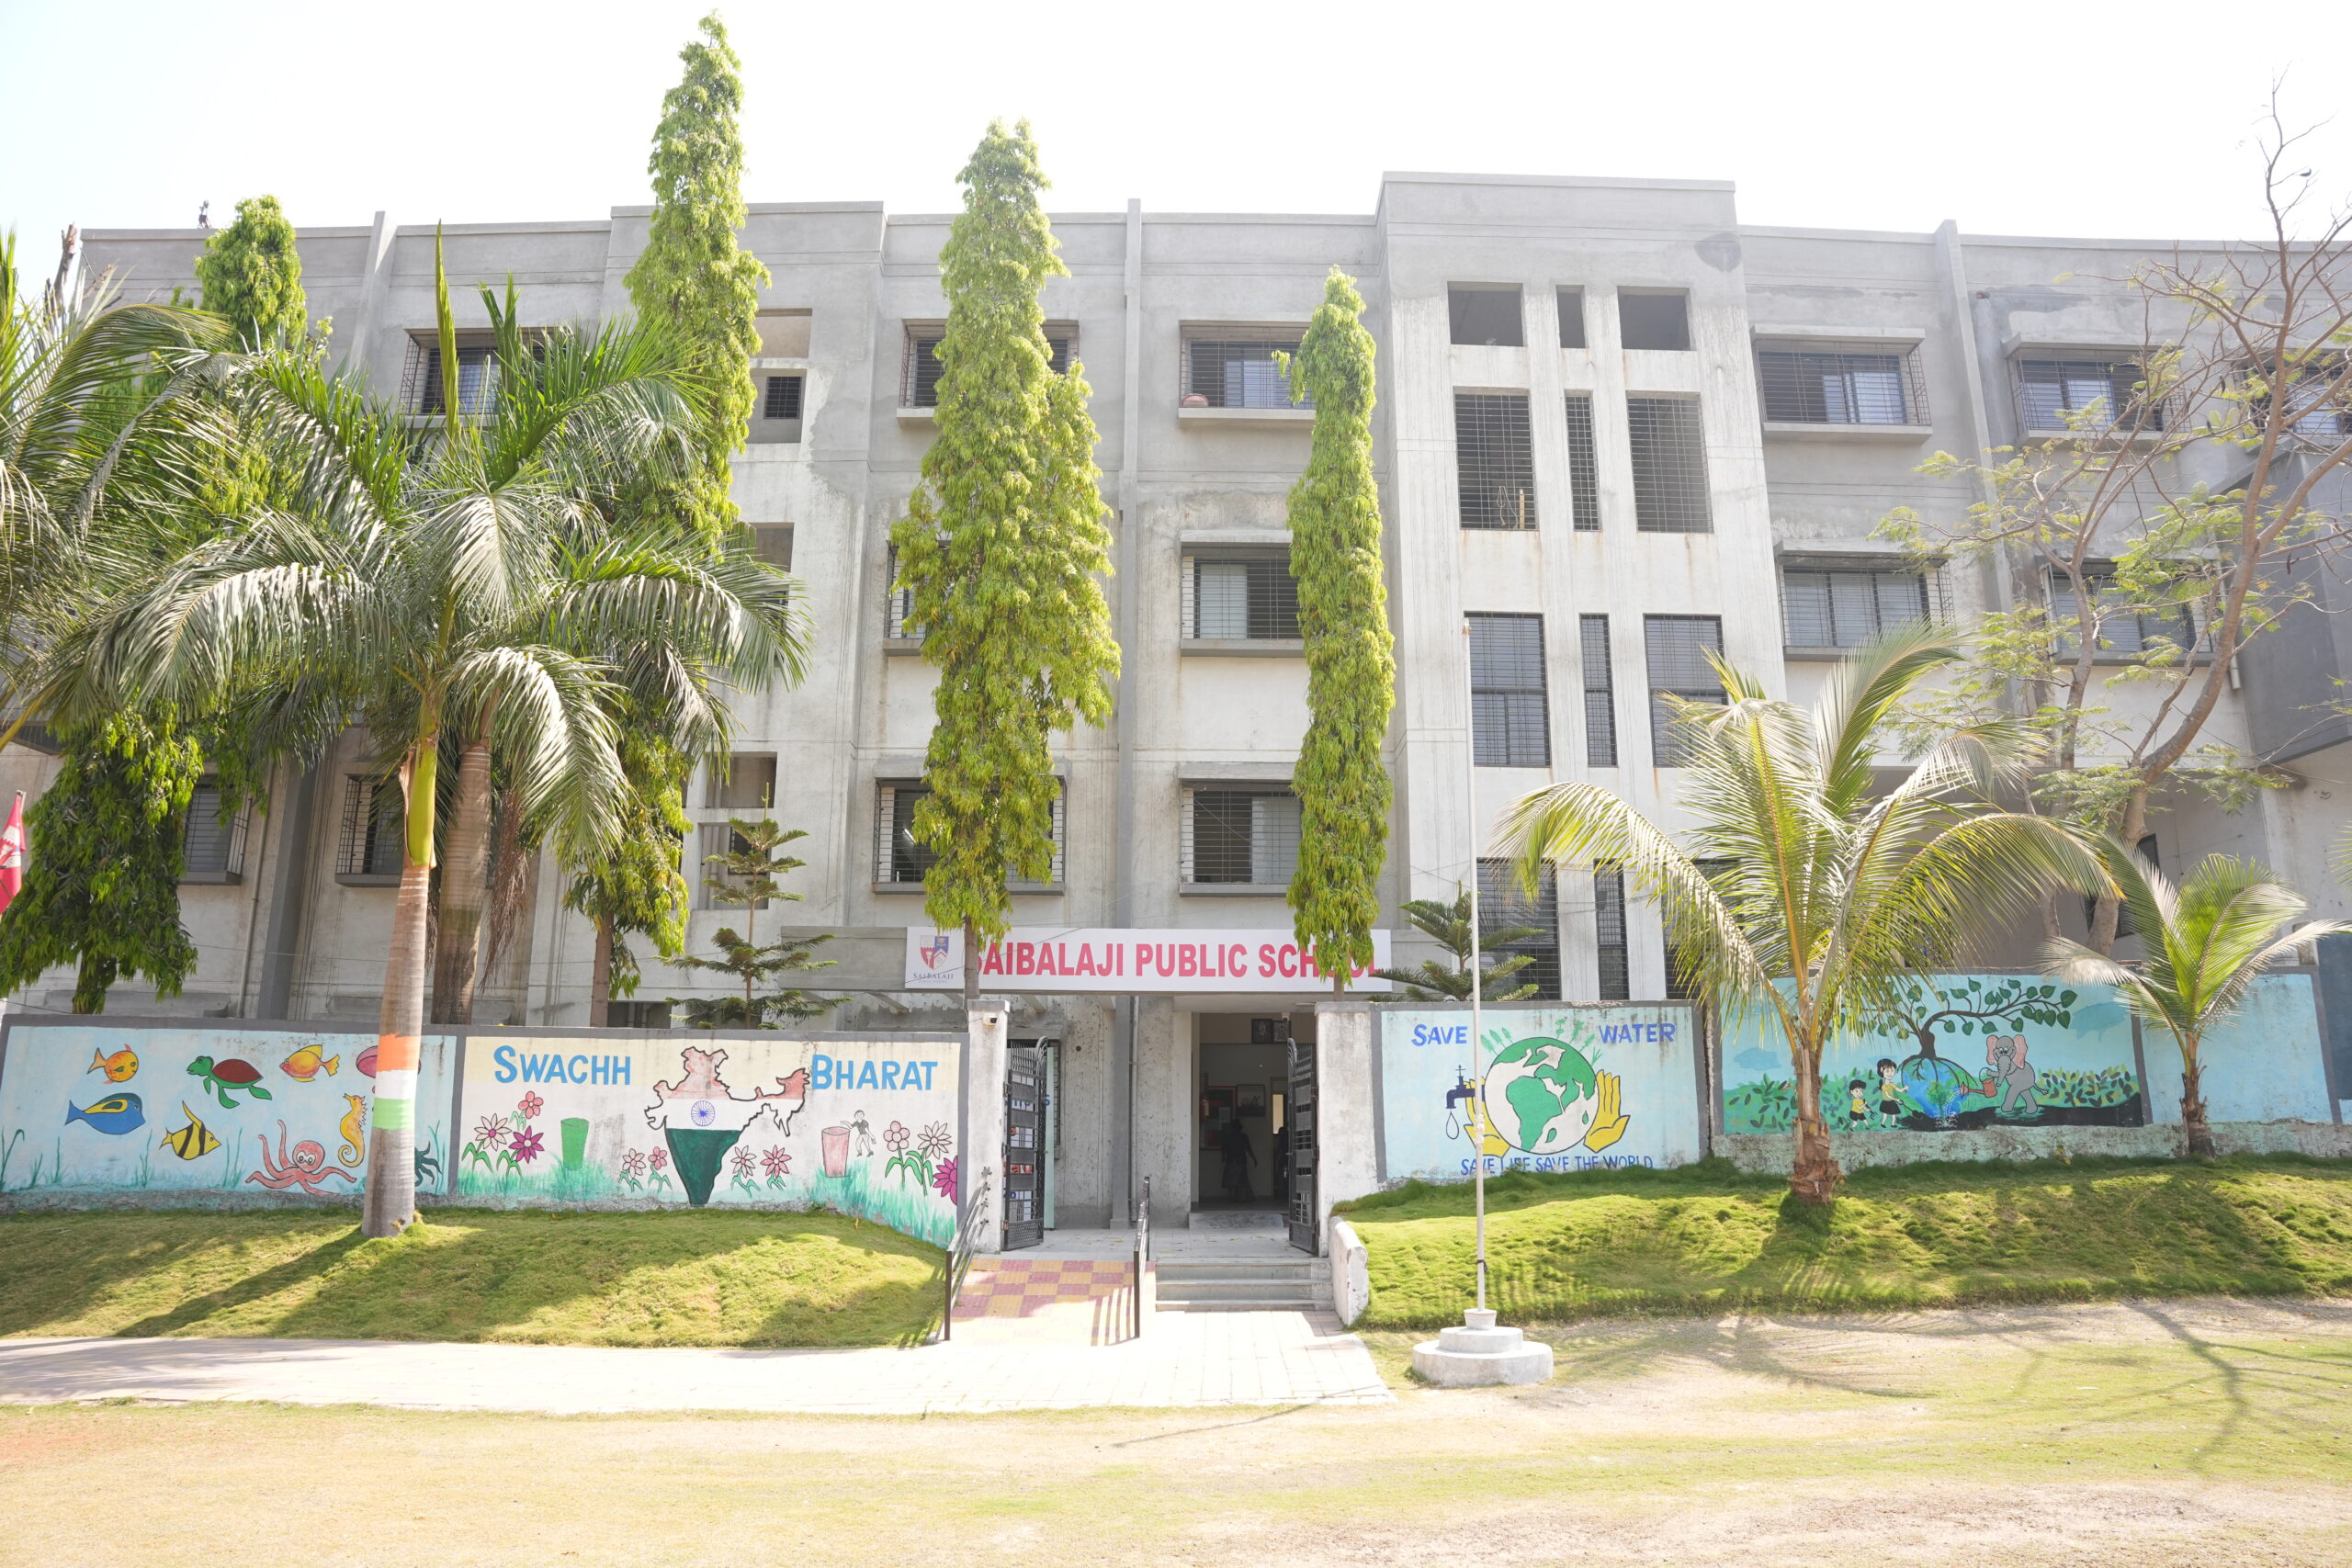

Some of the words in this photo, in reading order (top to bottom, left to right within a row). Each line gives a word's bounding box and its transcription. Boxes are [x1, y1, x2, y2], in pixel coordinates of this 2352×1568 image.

[978, 942, 1124, 977] AIBALAJI
[1136, 942, 1248, 978] PUBLIC
[1411, 1023, 1468, 1046] SAVE
[1599, 1022, 1677, 1043] WATER
[493, 1044, 631, 1086] SWACHH
[811, 1054, 938, 1091] BHARAT
[1575, 1156, 1599, 1171] THE
